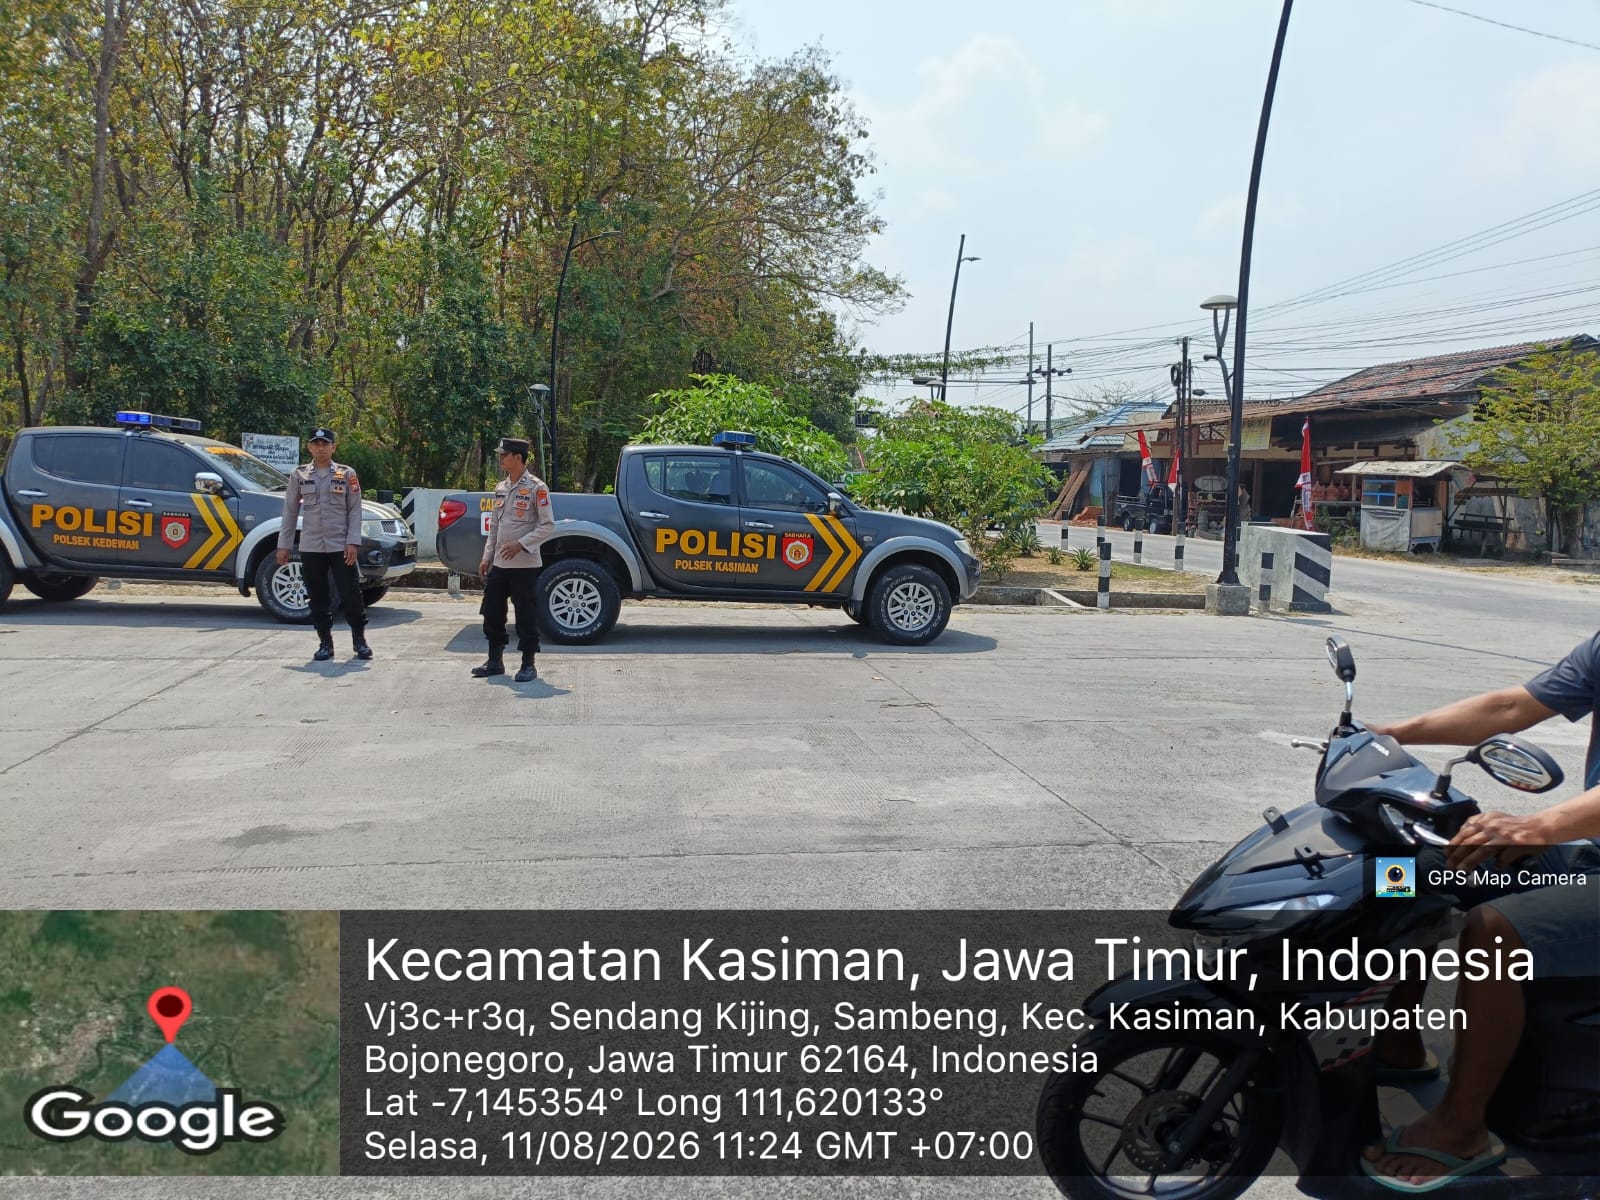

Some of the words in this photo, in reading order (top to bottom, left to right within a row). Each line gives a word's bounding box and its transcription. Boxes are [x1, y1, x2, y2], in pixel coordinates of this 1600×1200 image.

[31, 504, 154, 537] POLISI
[53, 534, 92, 547] POLSEK
[92, 537, 140, 550] KEDEWAN
[655, 527, 777, 560] POLISI
[675, 559, 713, 572] POLSEK
[715, 561, 759, 574] KASIMAN
